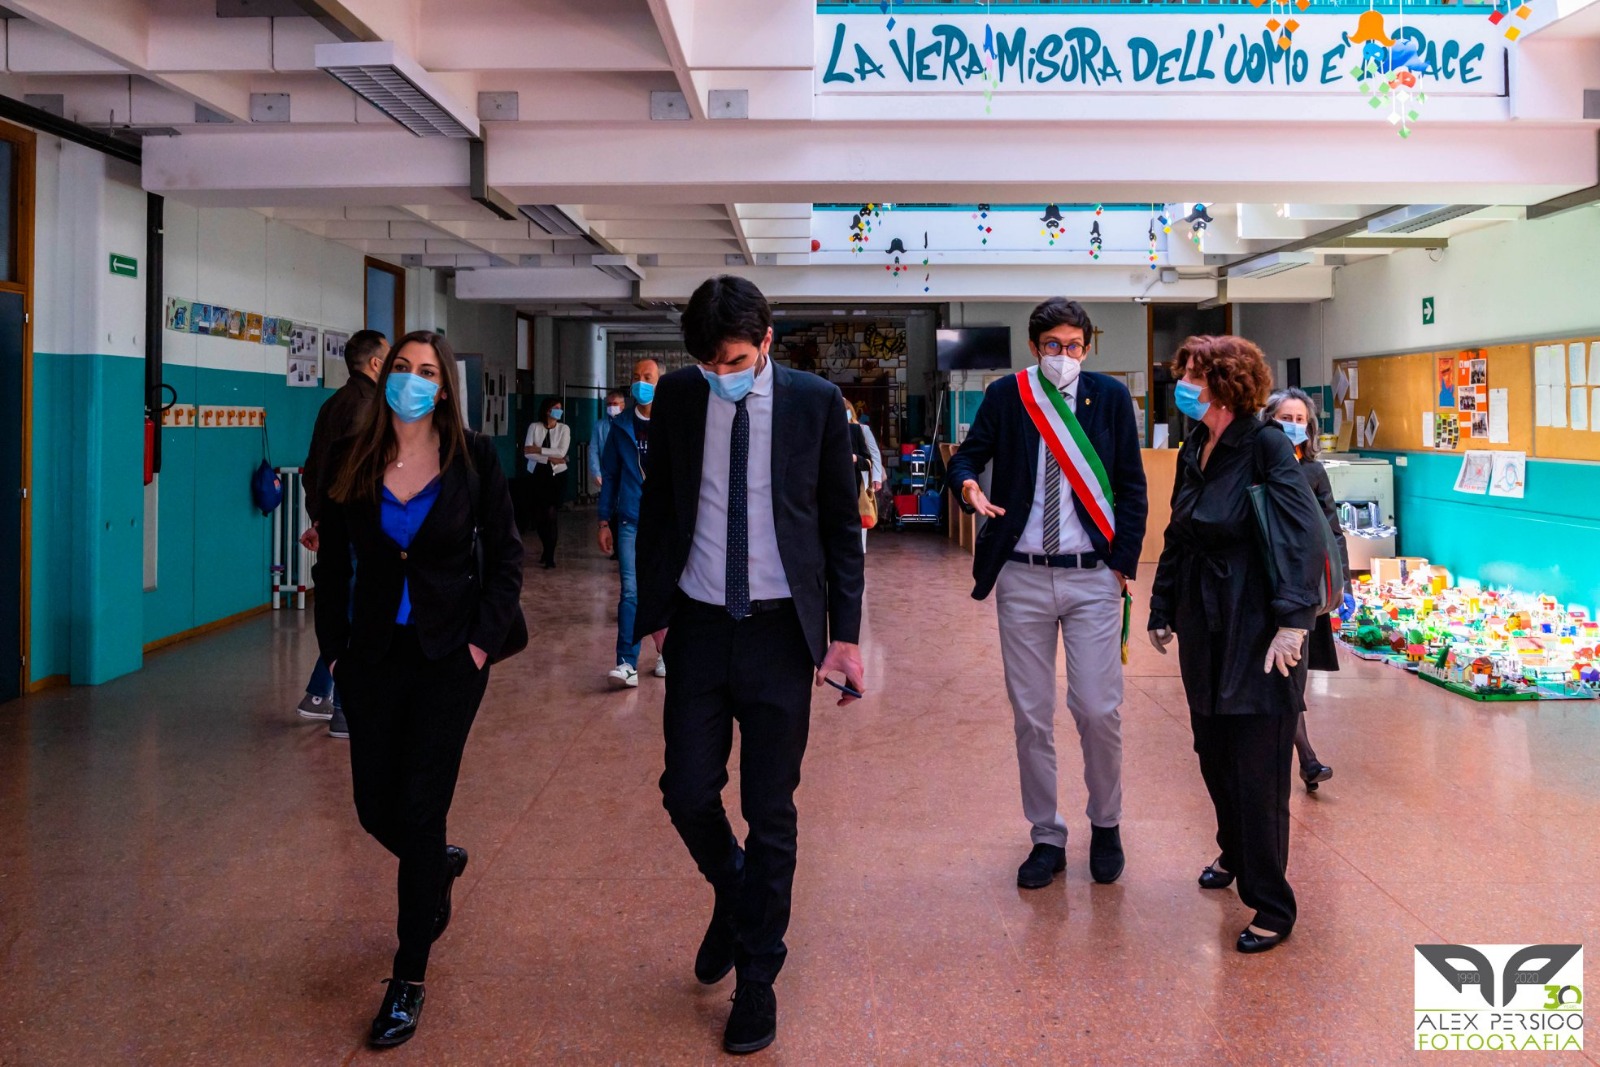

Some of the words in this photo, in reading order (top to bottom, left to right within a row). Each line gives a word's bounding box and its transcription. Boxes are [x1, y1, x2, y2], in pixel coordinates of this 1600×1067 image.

[823, 23, 885, 84] LA
[889, 24, 987, 85] VERA
[1127, 23, 1308, 85] DELL'UOMO
